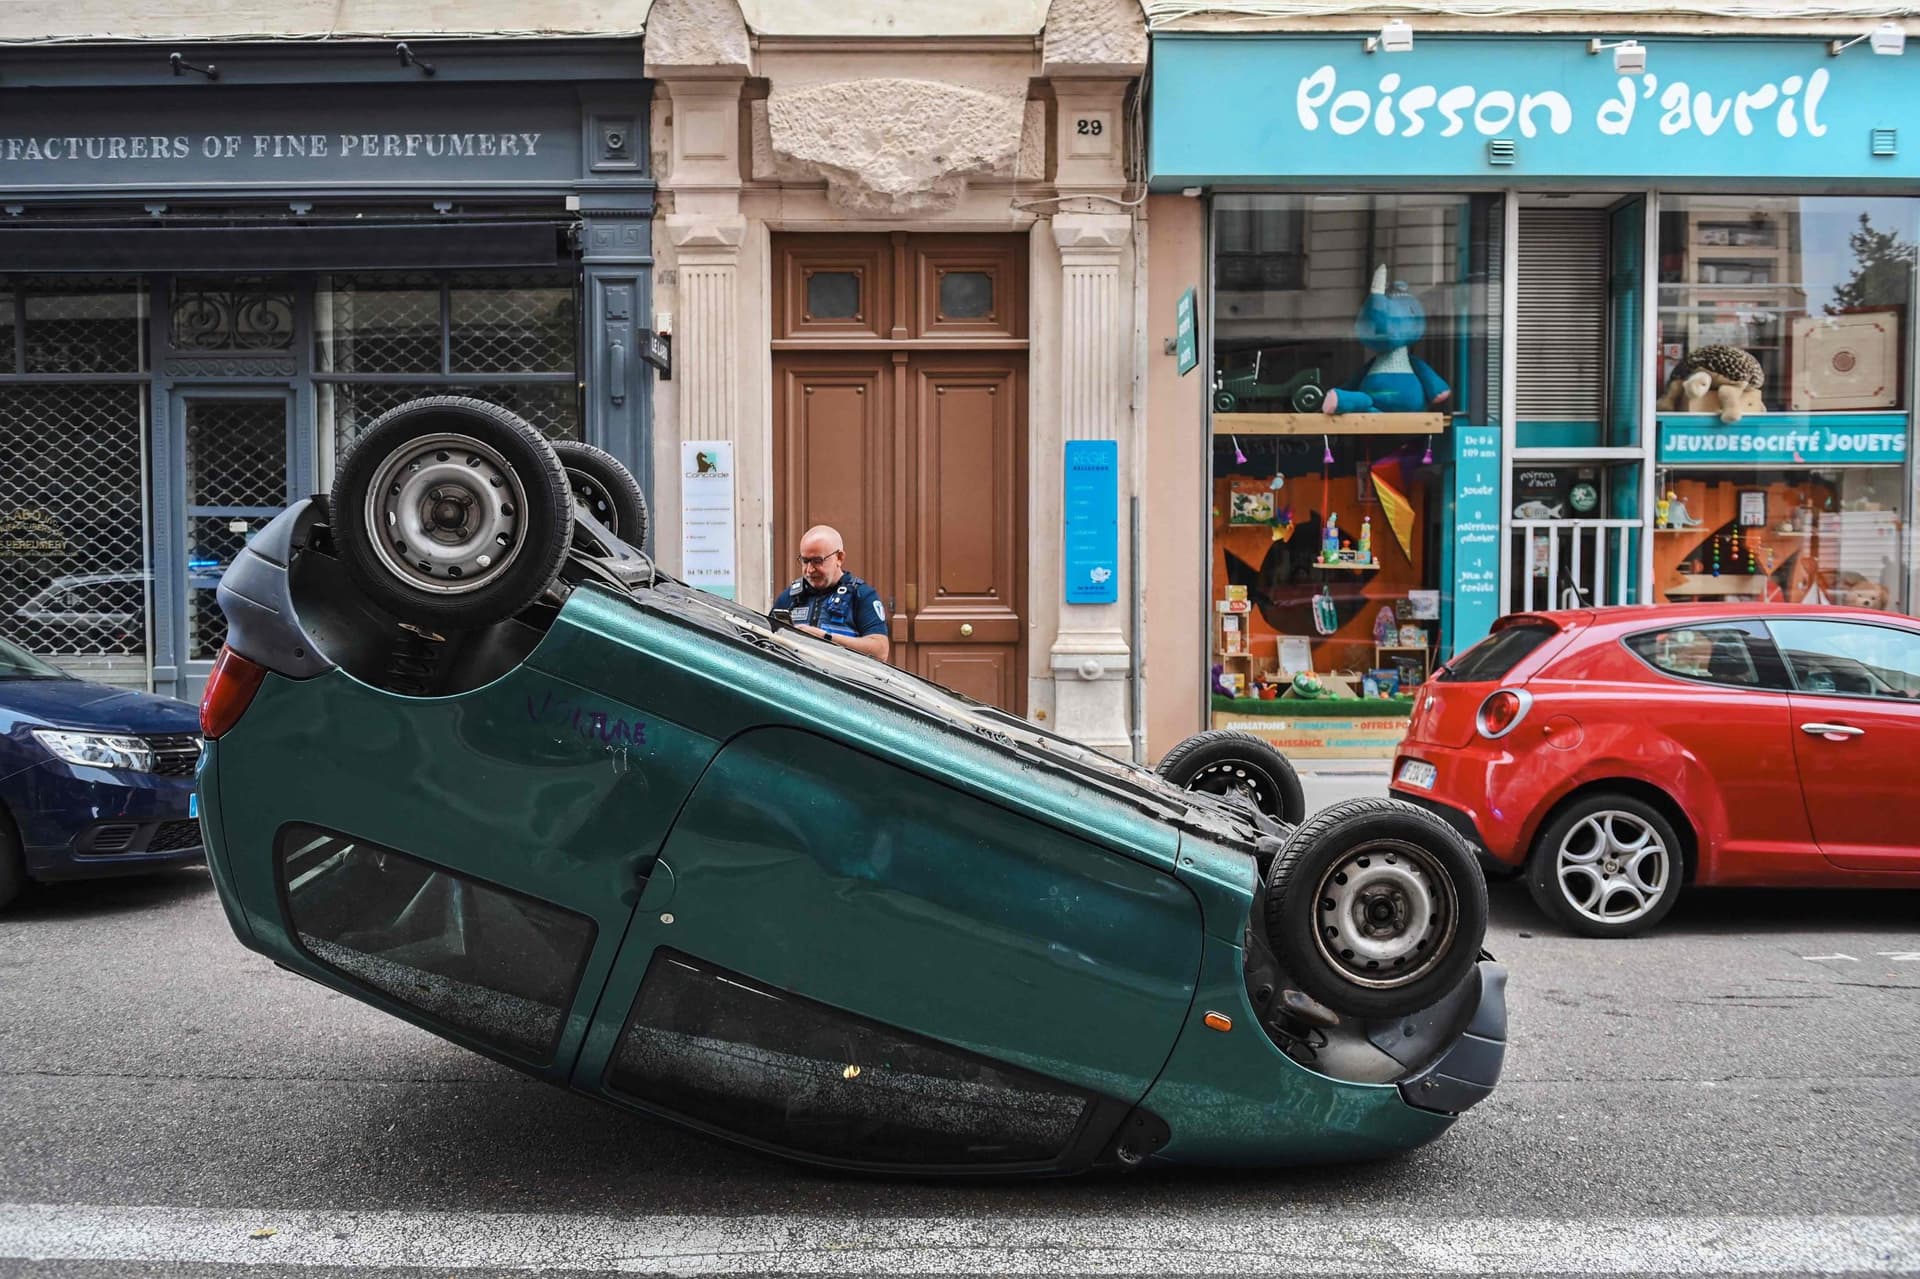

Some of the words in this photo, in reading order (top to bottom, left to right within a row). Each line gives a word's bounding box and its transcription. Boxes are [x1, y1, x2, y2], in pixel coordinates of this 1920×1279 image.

[1296, 65, 1572, 138] Poisson
[1596, 68, 1829, 137] d'avril
[1077, 119, 1103, 136] 29
[0, 135, 190, 160] FACTURERS
[202, 135, 242, 159] OF
[252, 135, 328, 158] FINE
[340, 133, 541, 157] PERFUMERY
[1825, 433, 1906, 452] JOUETS
